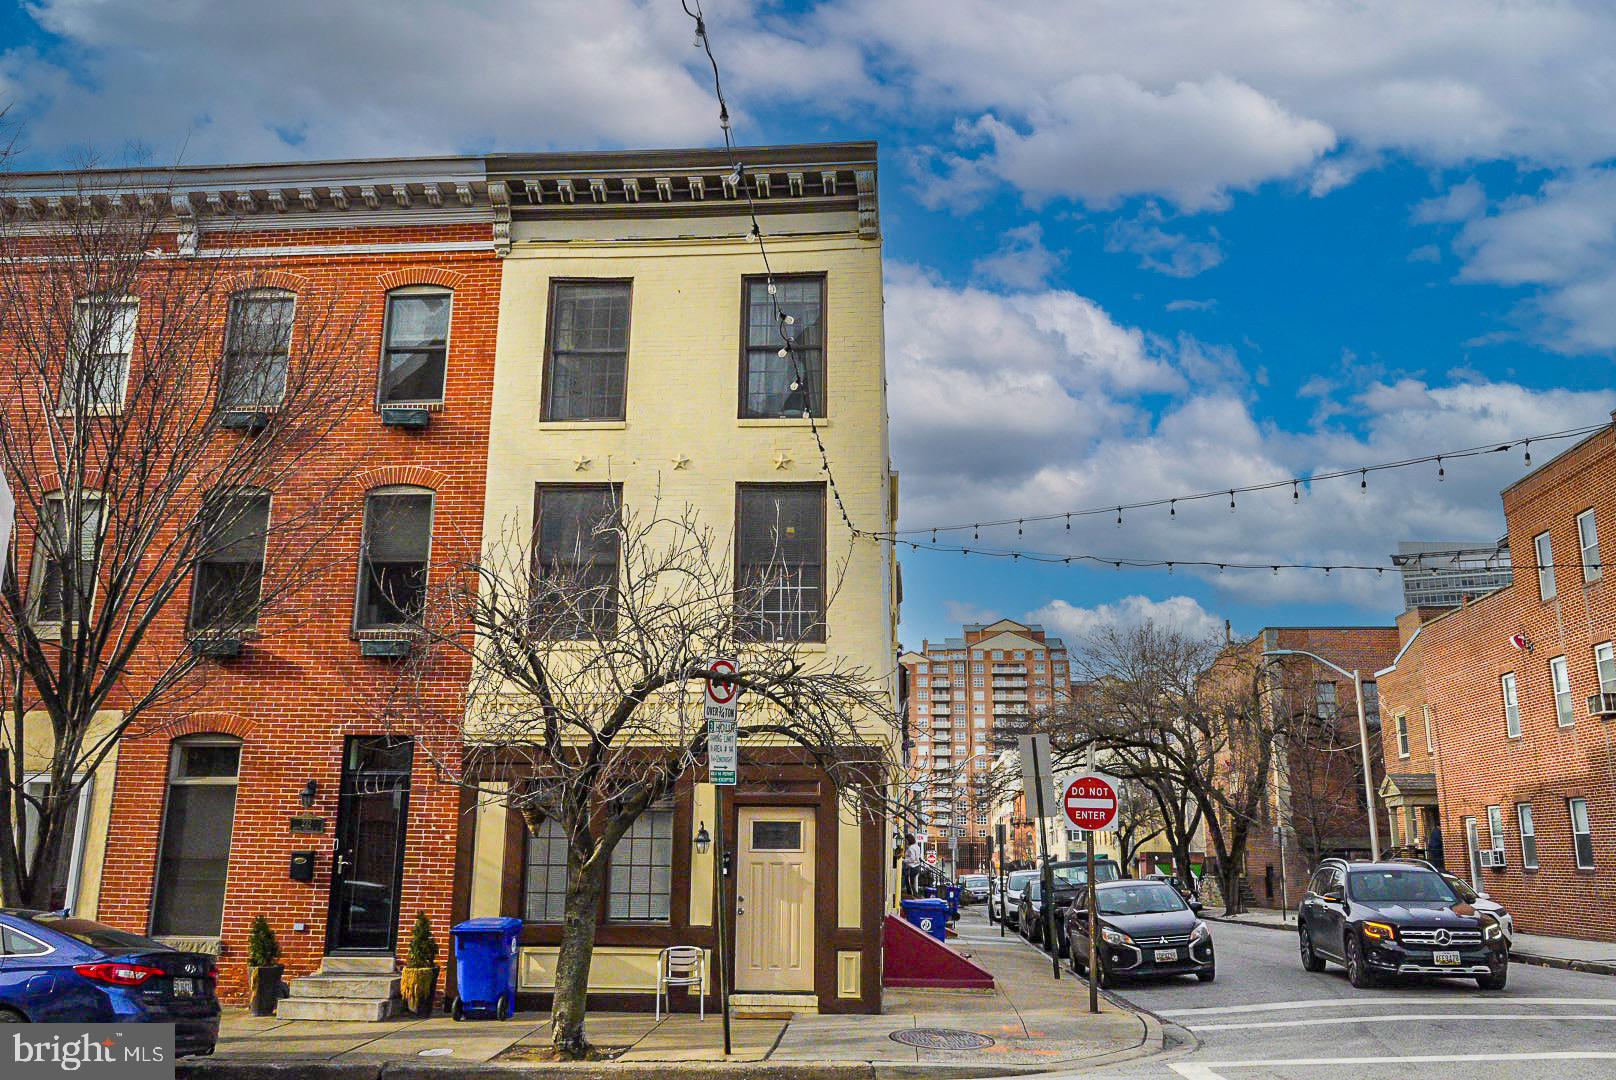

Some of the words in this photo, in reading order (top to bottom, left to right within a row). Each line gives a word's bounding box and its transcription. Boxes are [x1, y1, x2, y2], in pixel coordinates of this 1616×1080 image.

[706, 705, 718, 716] OVER
[725, 707, 734, 718] TON
[1071, 787, 1085, 796] DO
[1089, 787, 1109, 796] NOT
[1075, 811, 1106, 820] ENTER
